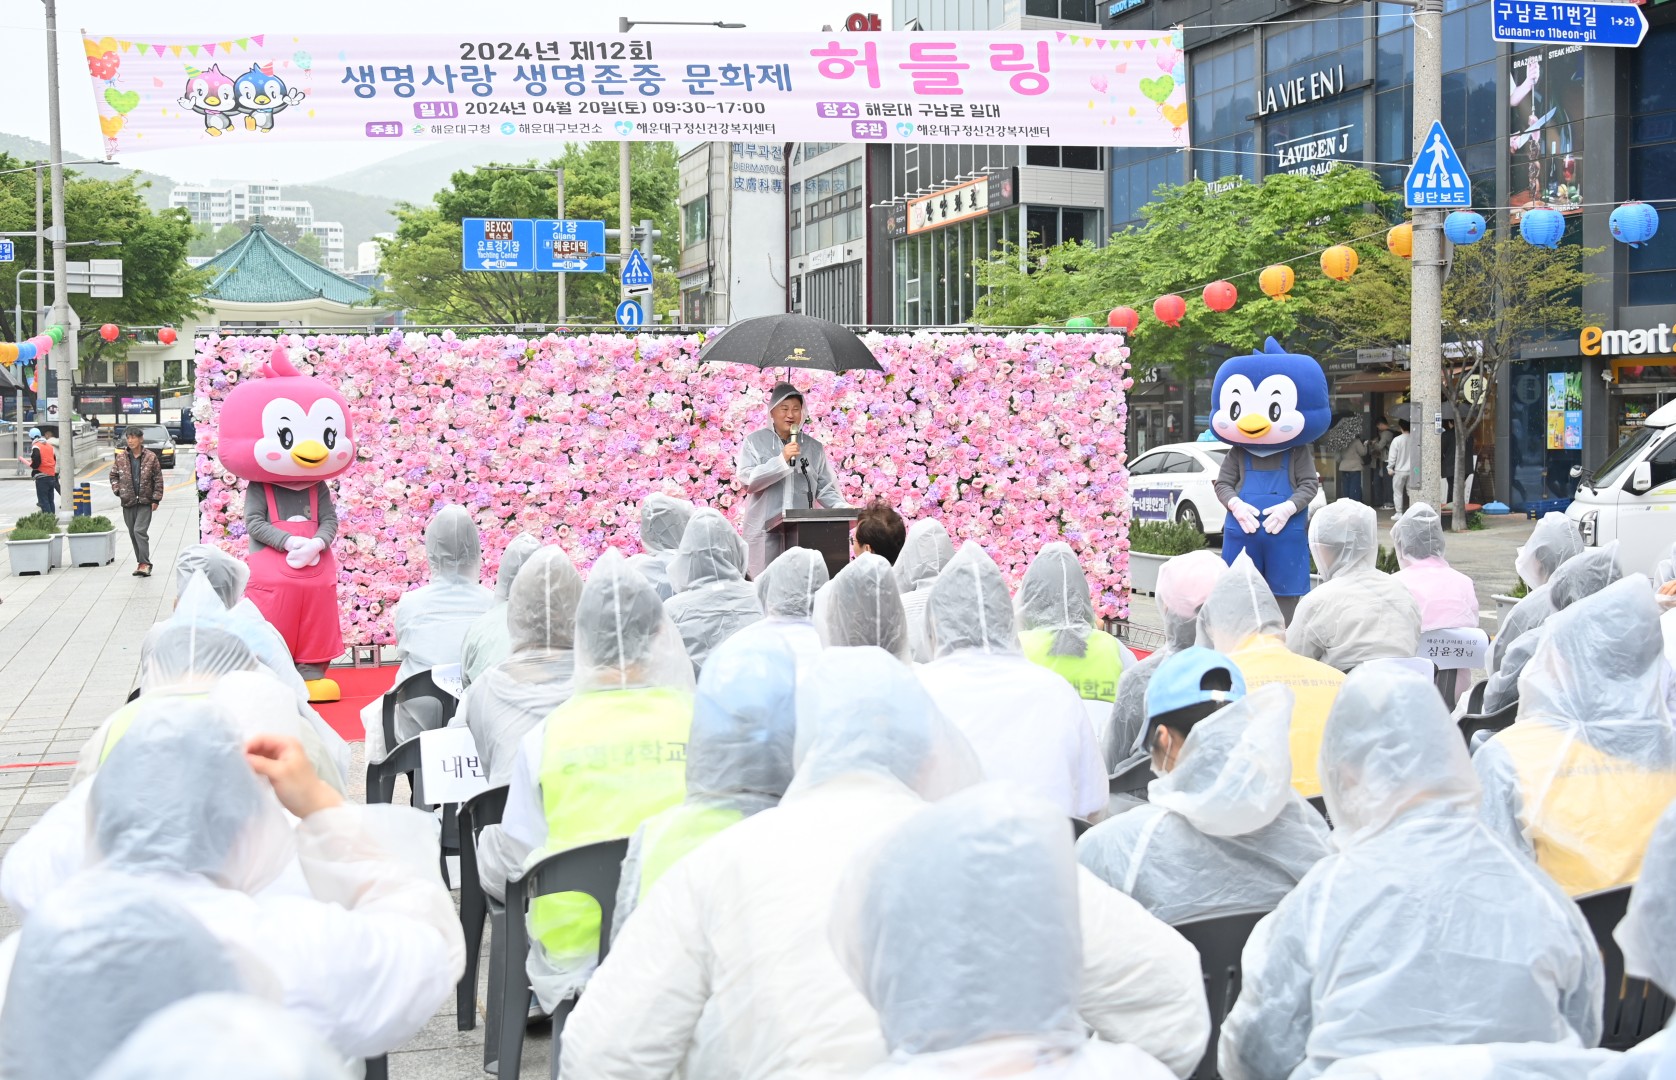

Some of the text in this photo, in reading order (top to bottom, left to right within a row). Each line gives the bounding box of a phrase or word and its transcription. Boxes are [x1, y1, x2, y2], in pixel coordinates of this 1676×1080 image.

[1498, 25, 1597, 42] Gunam-ro 11beon-gil
[459, 40, 653, 61] 2024년 제12회
[1548, 49, 1565, 60] STEAK
[1565, 45, 1583, 56] HOUSE
[341, 40, 1051, 99] 생명사랑 생명존중 문화제 허들링
[1257, 64, 1344, 116] LA VIE EN J
[419, 101, 766, 117] 일시 2024년 04월 20일(토) 09:30~17:00
[822, 102, 1001, 118] 장소 해운대 구남로 일대
[369, 122, 776, 136] 주최 해운대구청 해운대구보건소 해운대구정신건강복지센터
[855, 122, 1051, 138] 주관 해운대구정신건강복지센터
[1413, 191, 1466, 204] 횡단보도
[485, 220, 513, 233] BEXCO
[552, 221, 577, 233] 기장
[552, 232, 576, 240] Gijang
[477, 240, 520, 252] 요트경기장
[553, 240, 588, 252] 해운대역
[477, 251, 518, 260] Yachting Center
